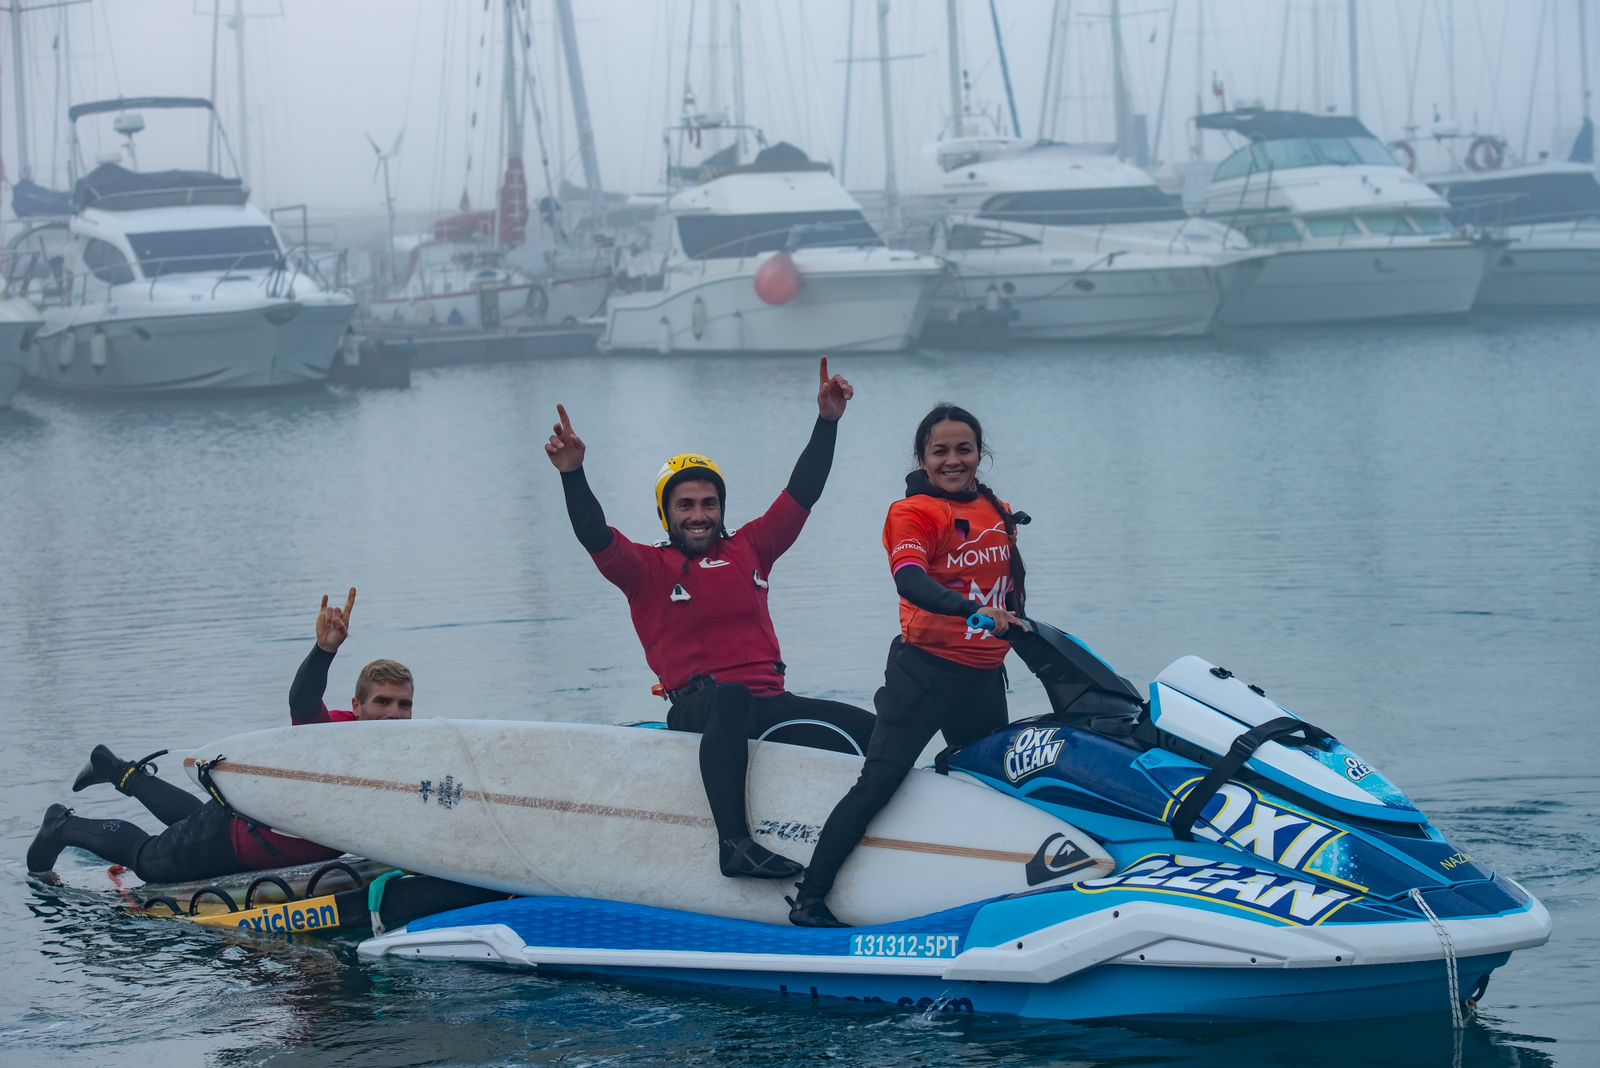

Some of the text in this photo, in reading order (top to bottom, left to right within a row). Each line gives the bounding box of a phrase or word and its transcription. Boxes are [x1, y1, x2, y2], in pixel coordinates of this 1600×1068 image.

[1015, 728, 1055, 753] OXI
[1005, 743, 1061, 780] CLEAN
[1172, 782, 1333, 871] OXI
[854, 935, 960, 957] 131312-5PT
